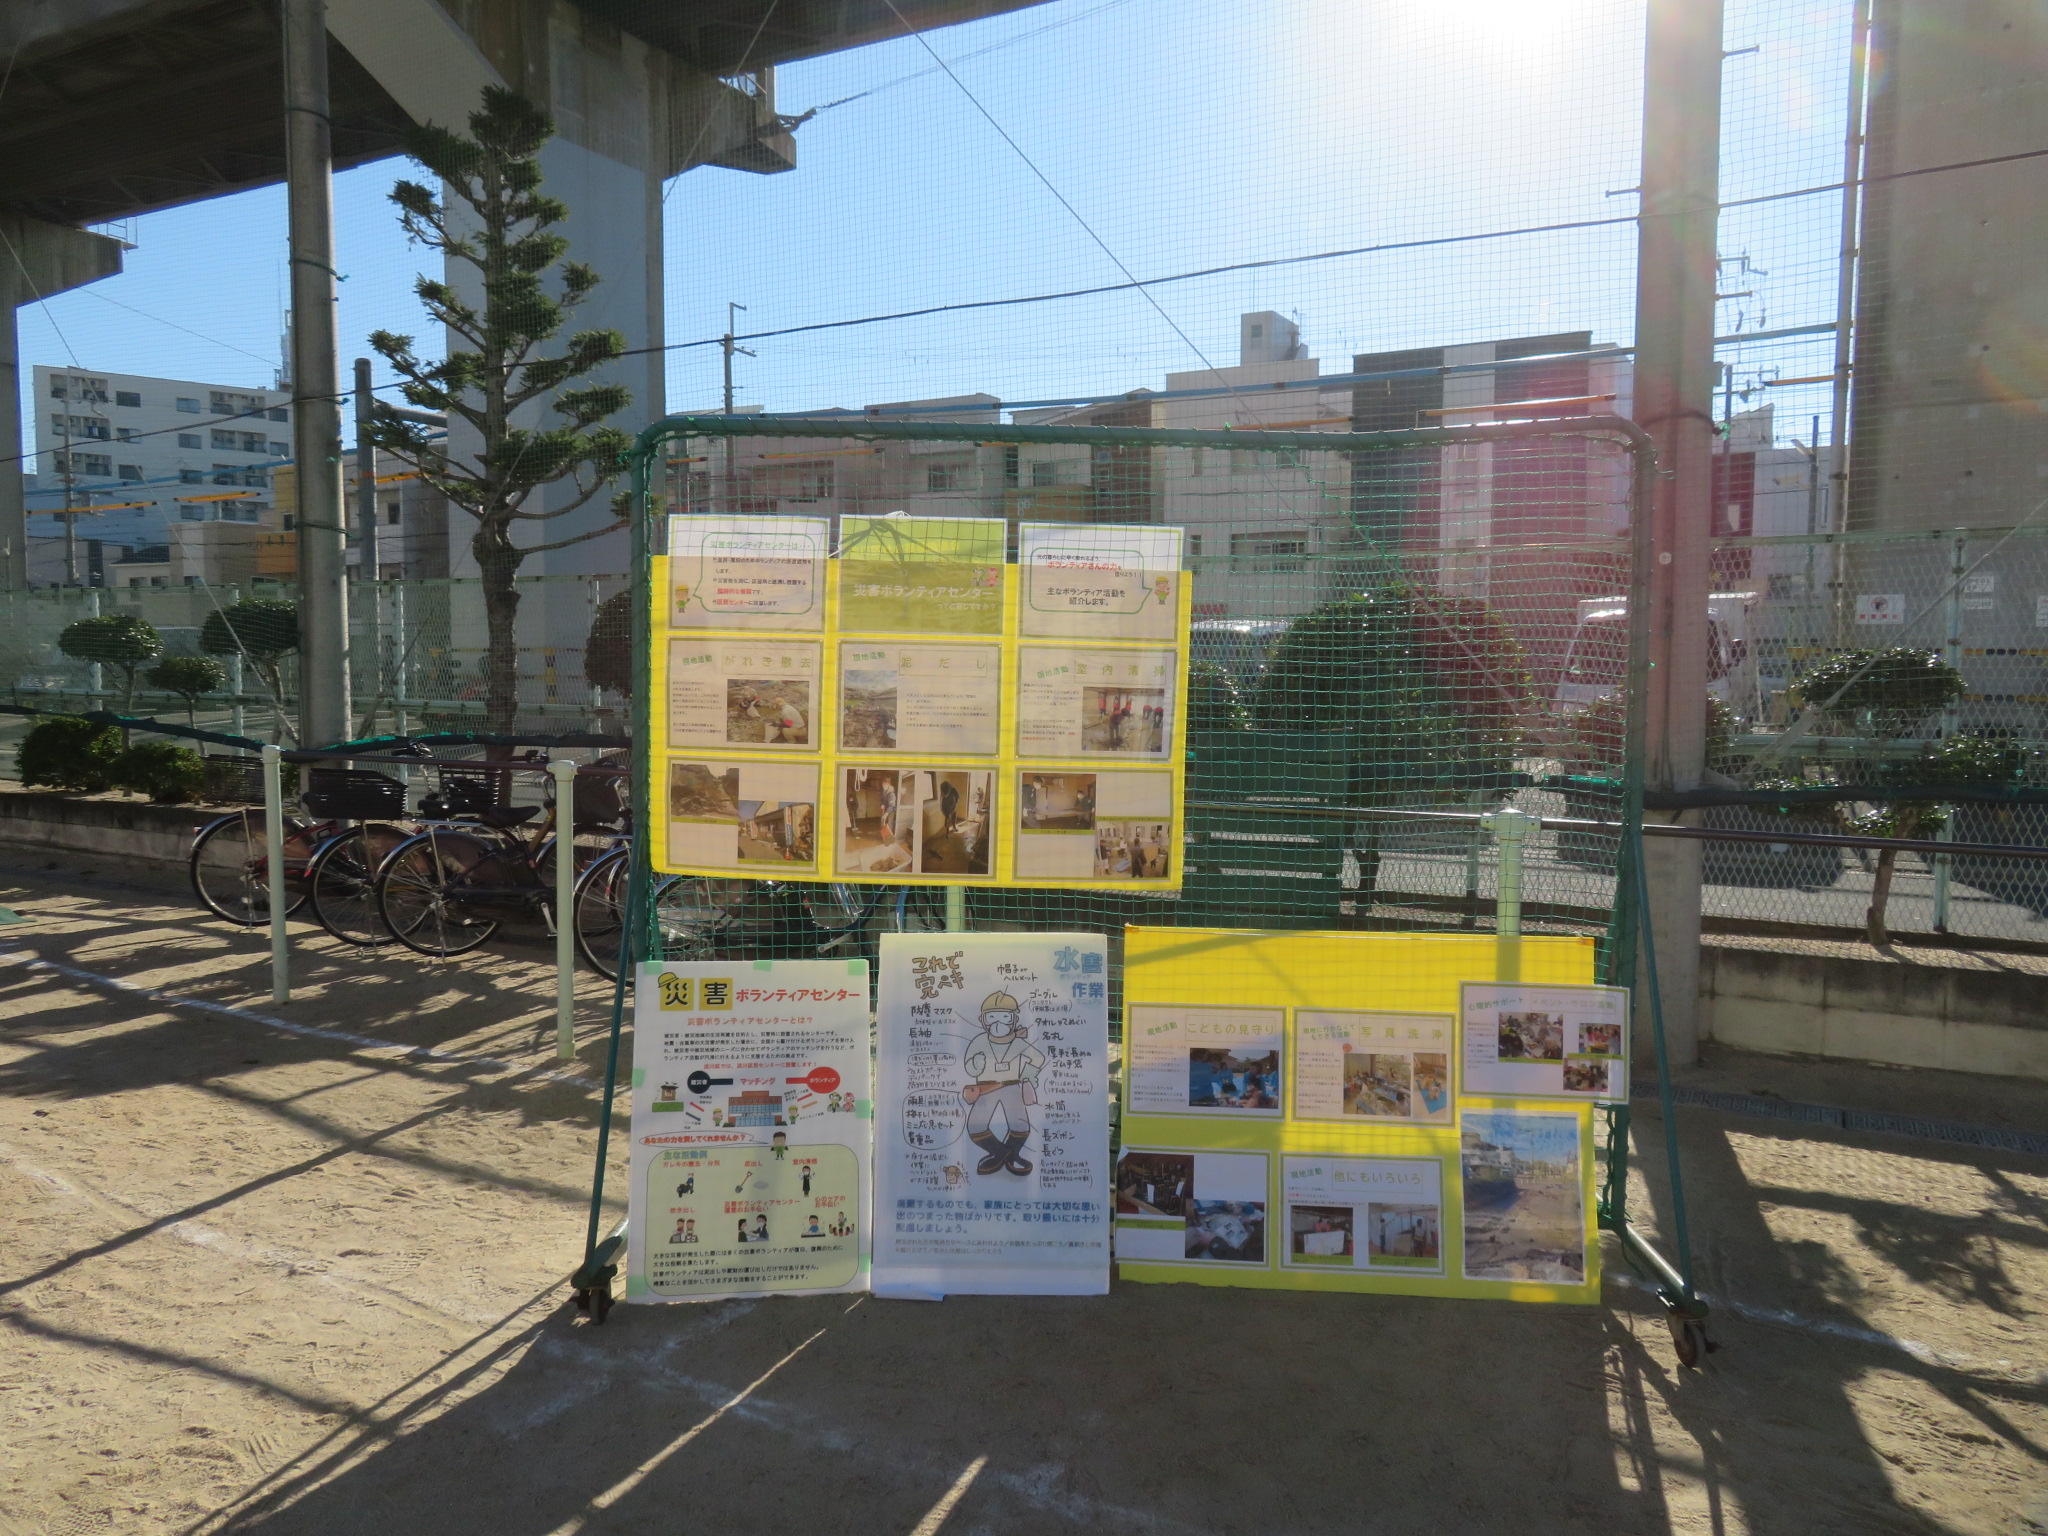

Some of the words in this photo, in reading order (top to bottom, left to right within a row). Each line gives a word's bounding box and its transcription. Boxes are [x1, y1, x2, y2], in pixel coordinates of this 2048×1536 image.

[853, 584, 994, 598] 災害ボランティアセンター
[1046, 587, 1126, 598] 主なボランティア活動を
[1069, 597, 1109, 606] 紹介します。
[682, 655, 713, 666] 現地活動
[723, 655, 812, 669] がれき撤去
[852, 651, 886, 662] 現地活動
[900, 657, 986, 670] 泥だし
[1036, 665, 1069, 679] 現地活動
[1076, 663, 1165, 677] 室内清掃
[912, 950, 964, 974] これで
[1053, 945, 1103, 974] 水害
[1003, 972, 1038, 982] ヘルメット
[665, 982, 728, 1006] 災害
[735, 988, 861, 1002] ボランティアセンター
[1029, 988, 1058, 999] ゴーグル
[1071, 981, 1105, 998] 作業
[910, 1002, 953, 1018] 防塵マスク
[1468, 997, 1523, 1011] 心理的サポート
[687, 1016, 814, 1026] 災害ボランティアセンターとは？
[909, 1027, 932, 1038] 長袖
[1146, 1022, 1178, 1036] 現地活動
[1187, 1023, 1275, 1036] こどもの見守り
[1361, 1026, 1443, 1040] 写真洗浄
[1042, 1031, 1064, 1041] 名札
[1052, 1058, 1083, 1069] ゴム手袋
[739, 1077, 776, 1086] マッチング
[1044, 1100, 1066, 1111] 水筒
[905, 1108, 927, 1119] 梅干し
[906, 1119, 954, 1130] ミニ応急セット
[644, 1135, 746, 1144] あなたの力を貸してくれませんか？
[907, 1131, 934, 1146] 貴重品
[1042, 1128, 1076, 1142] 長ズボン
[1042, 1143, 1064, 1157] 長ぐつ
[1290, 1167, 1323, 1179] 現地活動
[1334, 1170, 1421, 1184] 他にもいろいろ
[896, 1211, 1100, 1223] 出のつまった物ばかりです。取り扱いには十分
[895, 1222, 968, 1234] 配慮しましょう。
